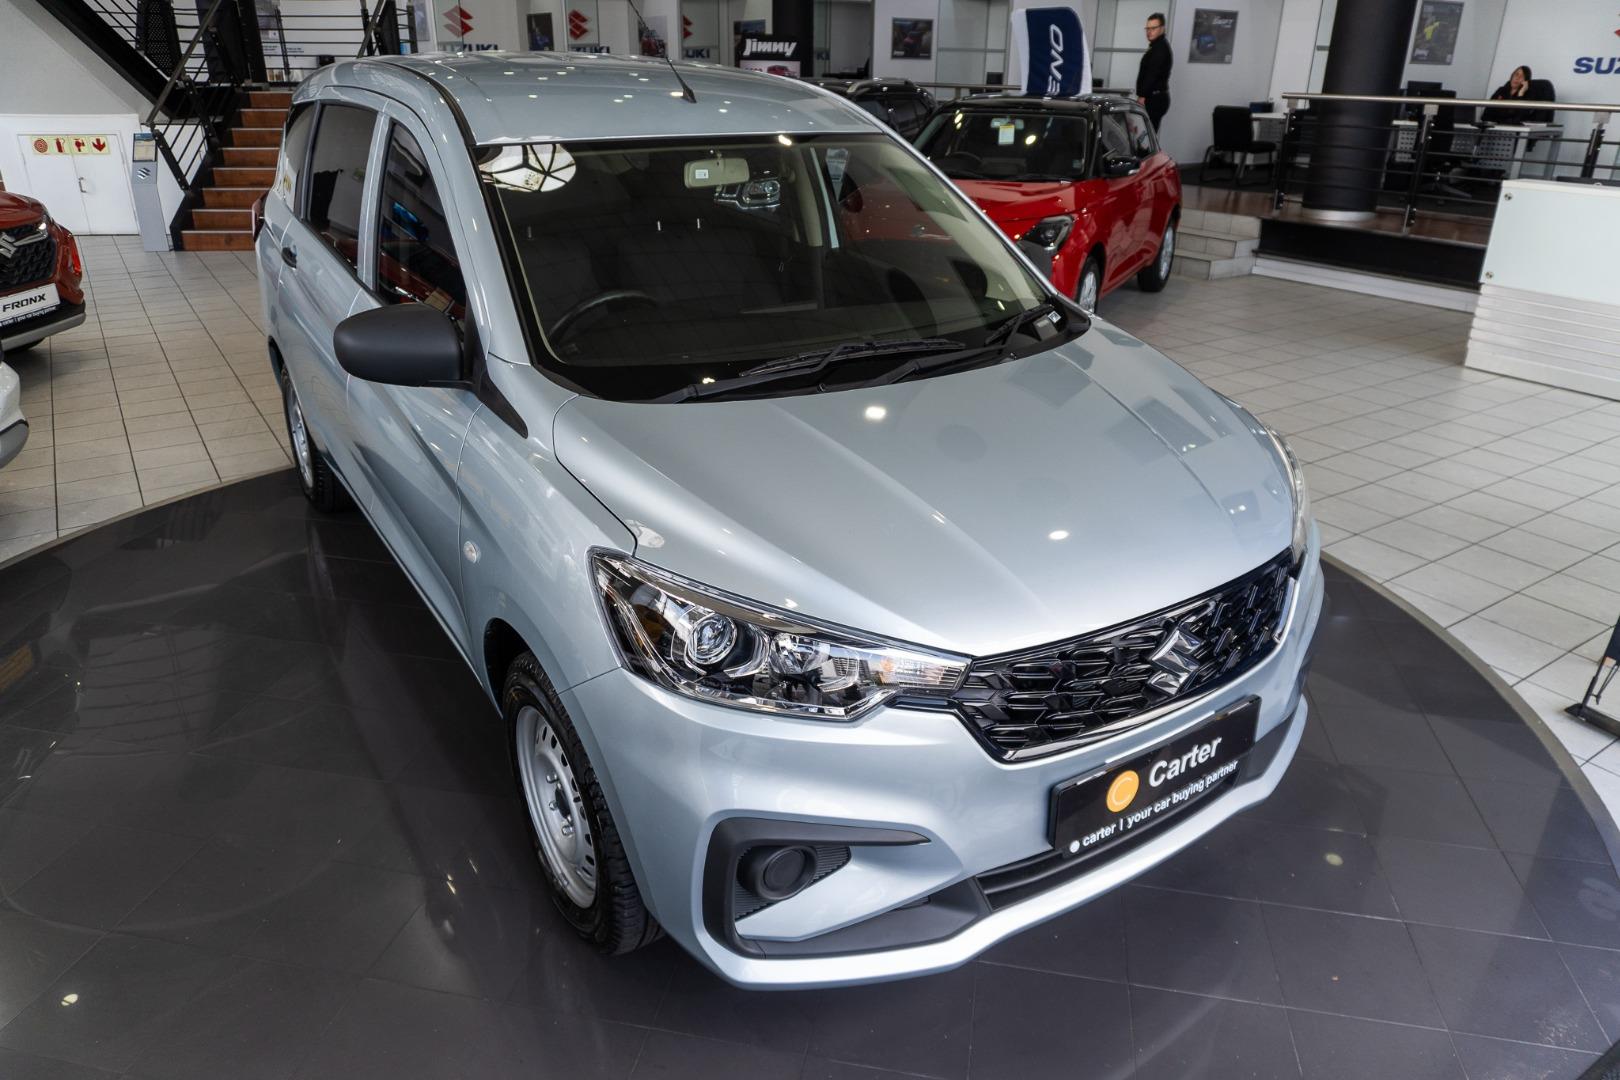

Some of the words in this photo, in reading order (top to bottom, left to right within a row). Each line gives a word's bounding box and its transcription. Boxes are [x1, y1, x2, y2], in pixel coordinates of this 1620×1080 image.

[743, 38, 797, 57] Jimny
[3, 293, 46, 312] FRONX
[1149, 736, 1223, 788] Carter
[1082, 823, 1117, 847] carter
[1127, 806, 1153, 829] your
[1153, 798, 1171, 813] car
[1172, 779, 1205, 804] buying
[1205, 760, 1239, 788] partner
